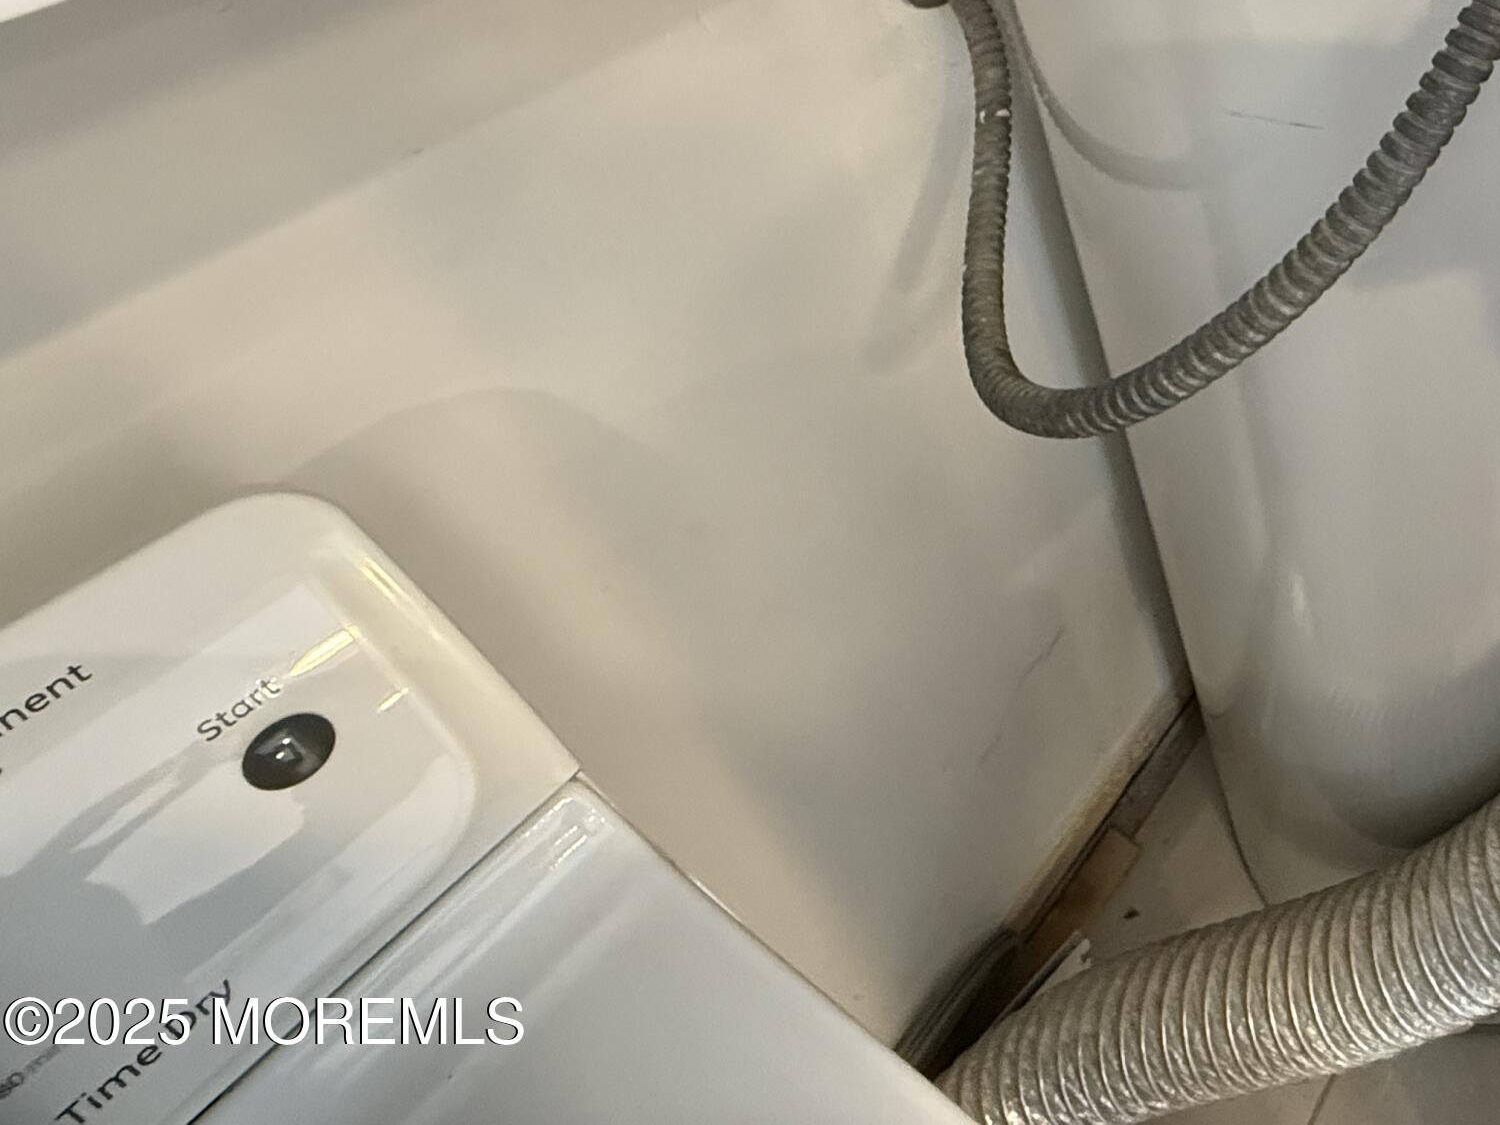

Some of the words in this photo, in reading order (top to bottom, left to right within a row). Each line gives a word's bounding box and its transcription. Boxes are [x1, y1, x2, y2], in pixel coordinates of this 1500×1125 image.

[0, 664, 94, 738] nent
[196, 678, 282, 742] Start
[54, 1043, 164, 1125] Time
